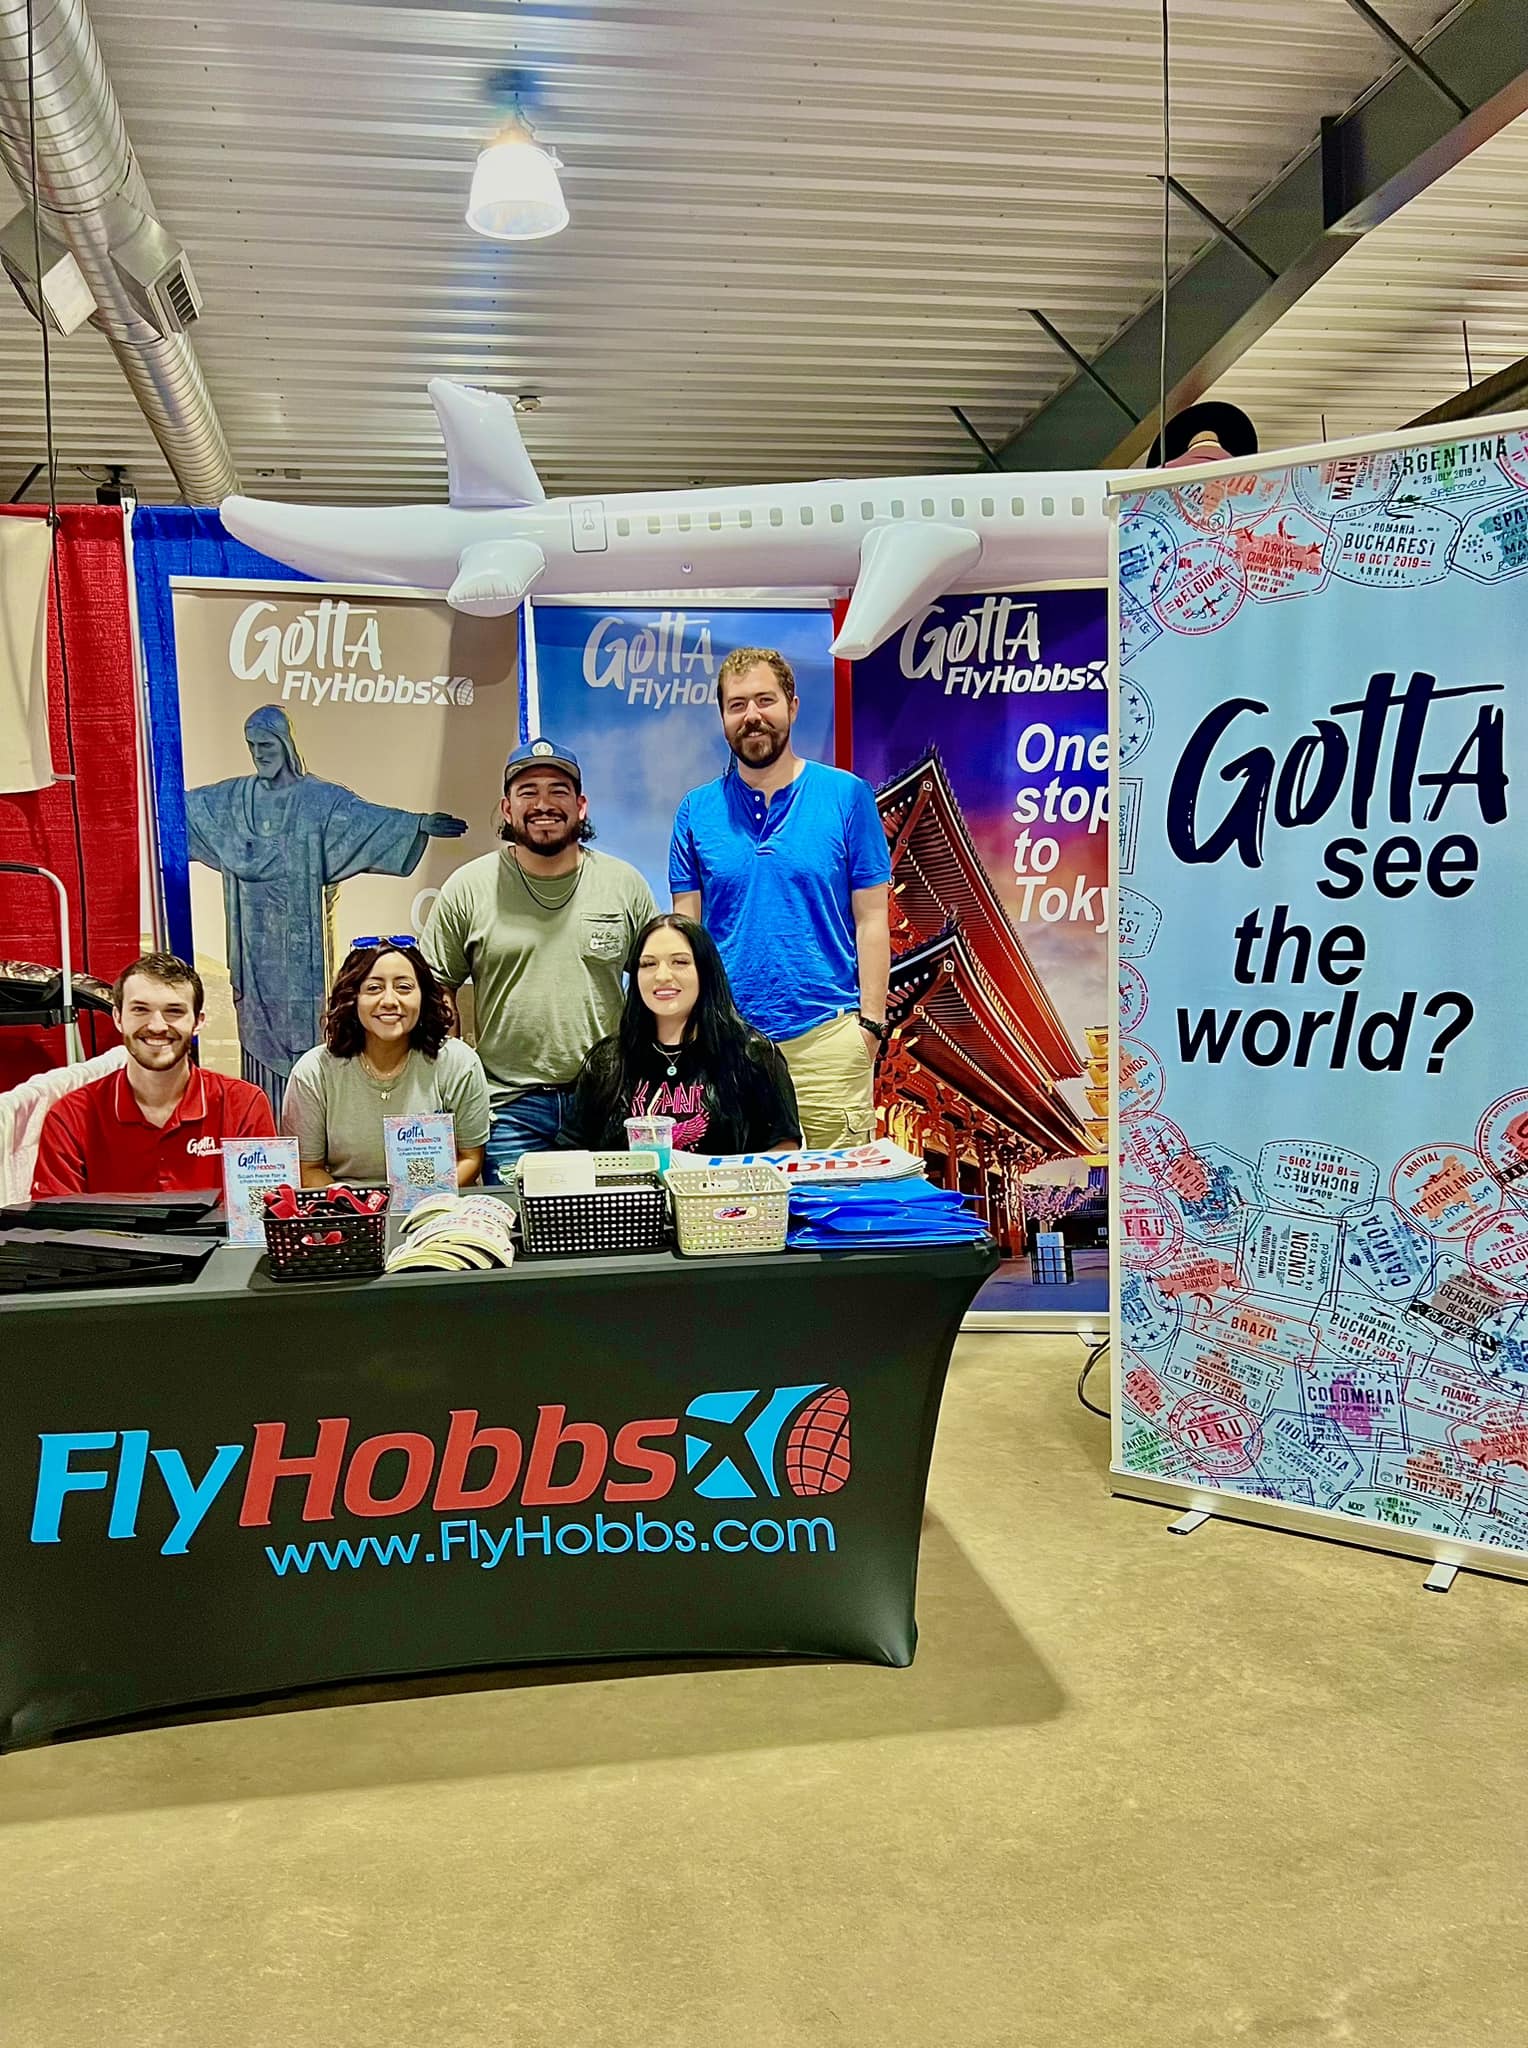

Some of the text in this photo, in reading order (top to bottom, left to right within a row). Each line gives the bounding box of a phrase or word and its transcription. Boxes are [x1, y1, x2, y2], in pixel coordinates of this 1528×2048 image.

[1389, 435, 1507, 479] ARGENTINA
[1331, 462, 1358, 500] MAN
[1343, 533, 1436, 556] BUCHAREST
[1393, 555, 1420, 569] 2019
[1174, 566, 1228, 609] BELGIUM
[281, 670, 431, 707] FlyHobbs
[627, 678, 719, 709] FlyHob
[944, 663, 1088, 699] FlyHobbs
[1016, 723, 1110, 774] One
[1013, 827, 1060, 874] to
[1316, 834, 1480, 900] see
[1015, 876, 1110, 934] Toky
[1233, 904, 1367, 986] the
[1176, 990, 1475, 1075] world?
[776, 1157, 892, 1173] bbs
[1276, 1164, 1360, 1195] BUCHAREST
[1403, 1151, 1441, 1179] ARRIVAL
[1409, 1167, 1485, 1218] NETHERLANDS
[1124, 1219, 1165, 1237] ERU
[1286, 1230, 1310, 1287] LONDON
[1308, 1258, 1317, 1276] MAY
[1361, 1214, 1412, 1287] CANADA
[1489, 1245, 1528, 1270] BELGI
[1231, 1316, 1279, 1342] BRAZIL
[1445, 1302, 1480, 1324] BERLIN
[1329, 1312, 1412, 1357] BUCHAREST
[1125, 1370, 1165, 1411] POLAND
[1183, 1368, 1248, 1405] VENEZUELA
[1307, 1386, 1395, 1405] COLOMBIA
[1187, 1418, 1243, 1447] PERU
[29, 1404, 680, 1556] FlyHobbs
[264, 1512, 838, 1578] www.FlyHobbs.com
